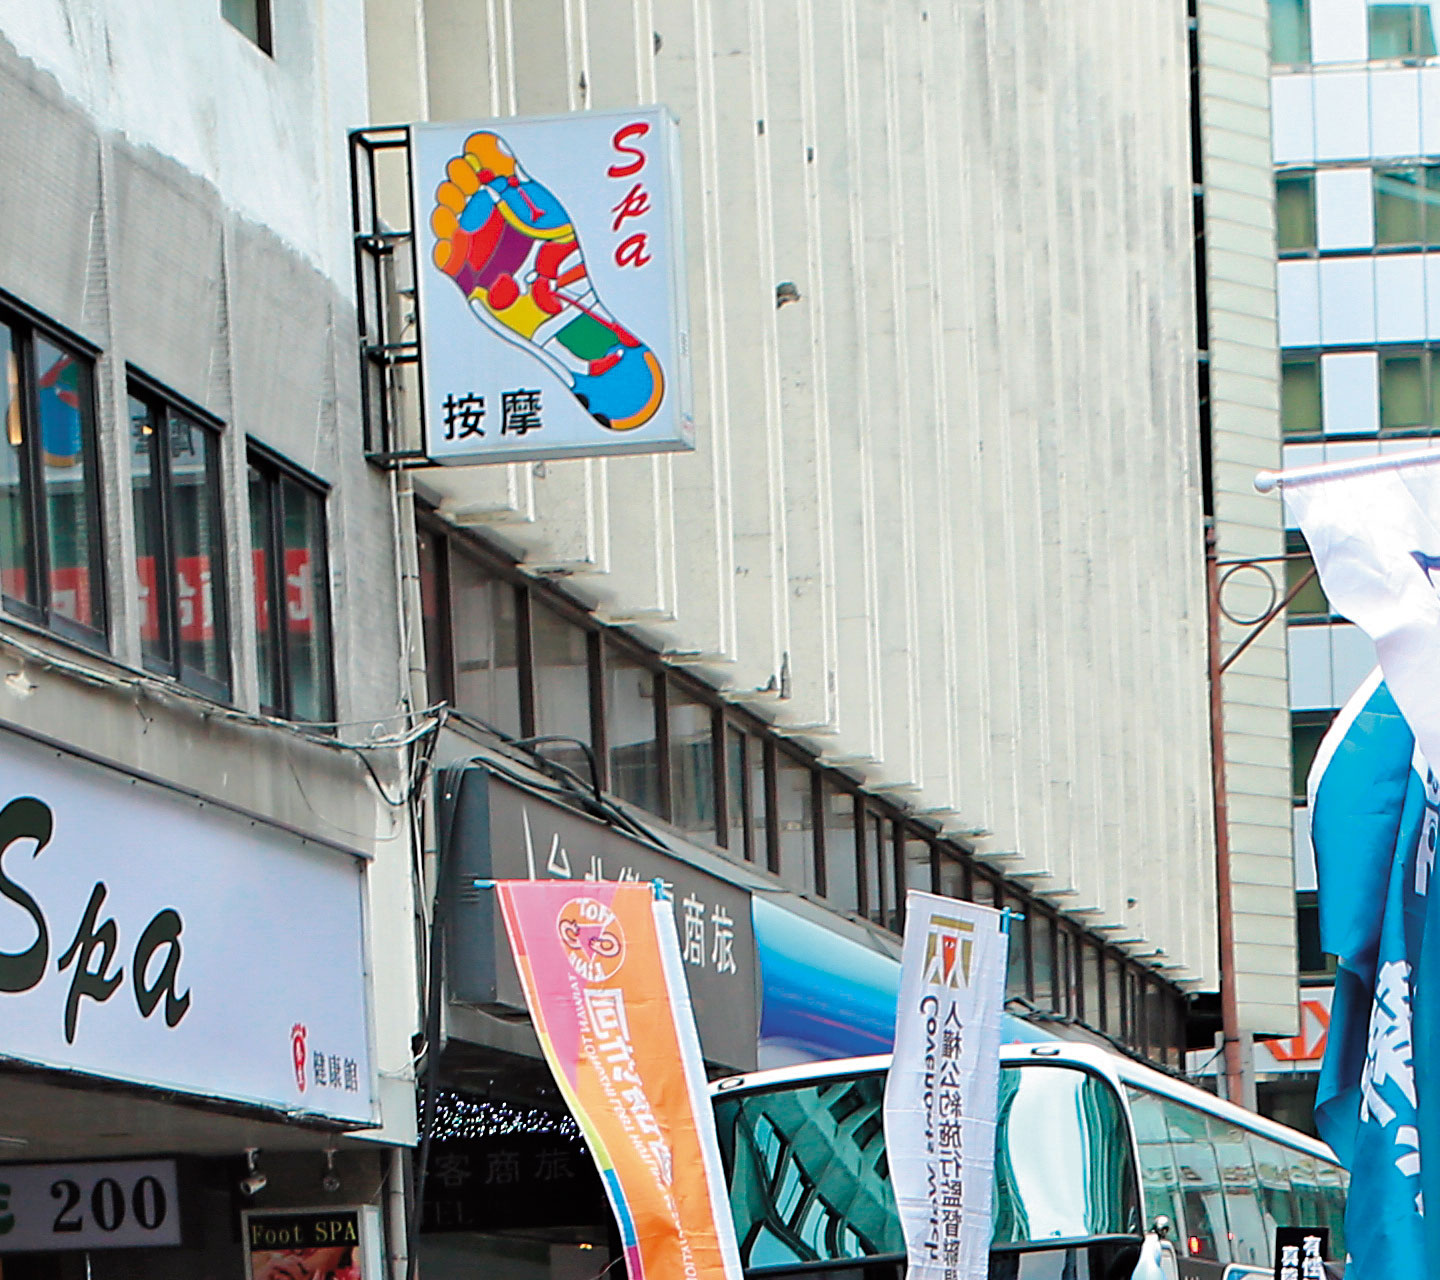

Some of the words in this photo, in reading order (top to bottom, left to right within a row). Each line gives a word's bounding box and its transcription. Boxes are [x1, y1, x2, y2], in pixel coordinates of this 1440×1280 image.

[606, 121, 652, 269] Spa
[441, 388, 544, 440] 按摩
[49, 1174, 169, 1233] 200
[250, 1223, 304, 1246] Foot
[314, 1220, 357, 1243] SPA
